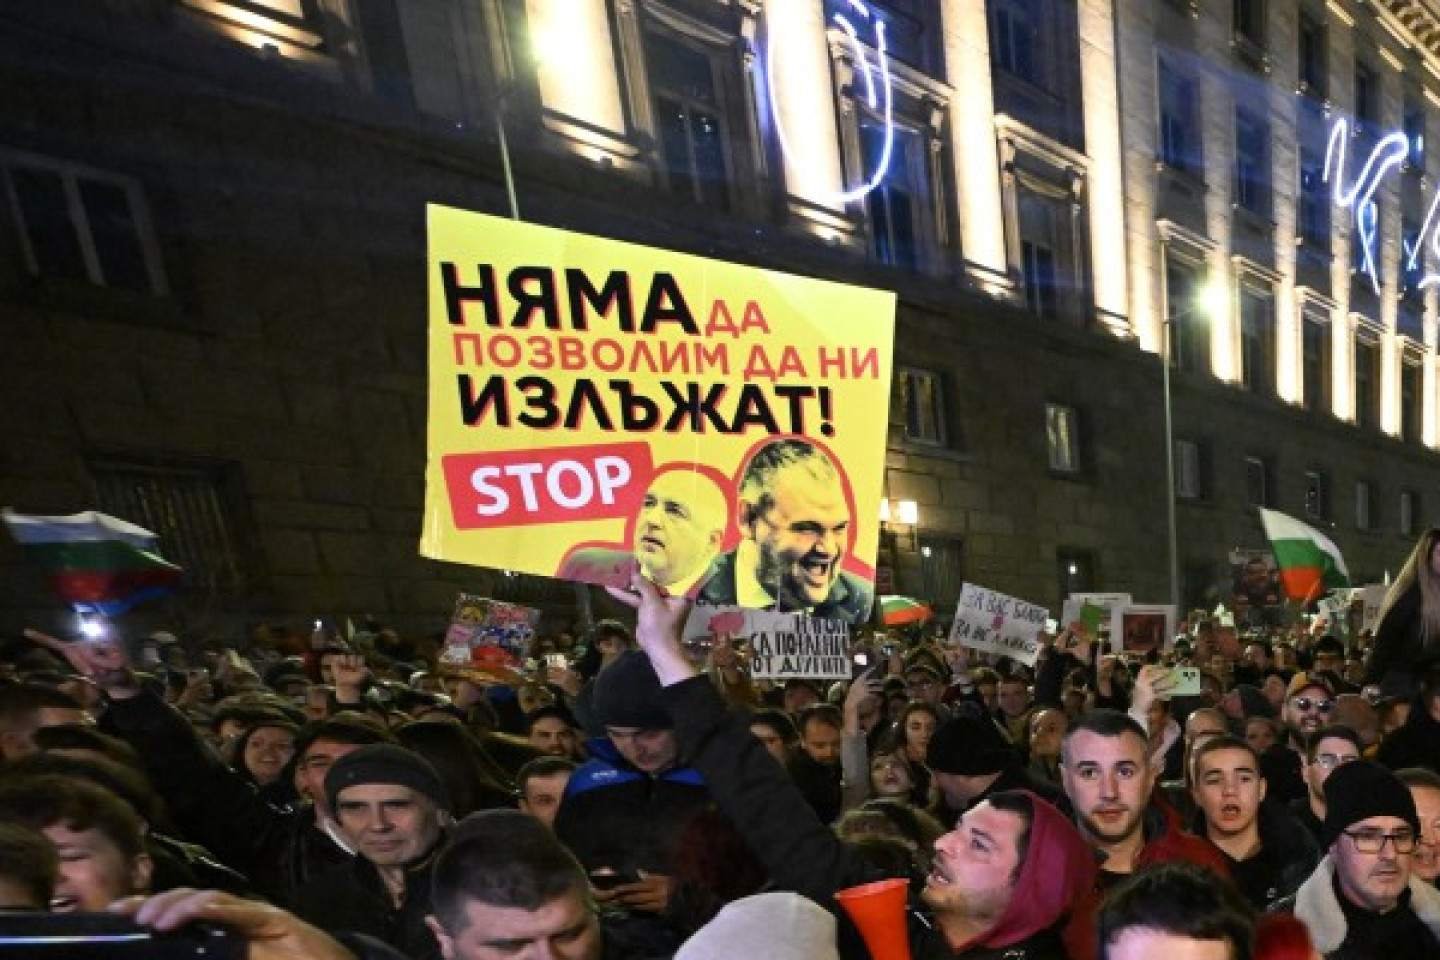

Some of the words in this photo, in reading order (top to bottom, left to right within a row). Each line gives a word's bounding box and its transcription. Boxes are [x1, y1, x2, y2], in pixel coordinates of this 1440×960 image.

[440, 261, 700, 336] НЯМА
[705, 299, 771, 338] ДА
[453, 331, 730, 376] ПОЗВОЛИМ
[743, 342, 807, 382] ДА
[818, 346, 879, 379] НИ
[457, 373, 836, 437] ИЗЛЪЖАТ!
[470, 455, 632, 517] STOP
